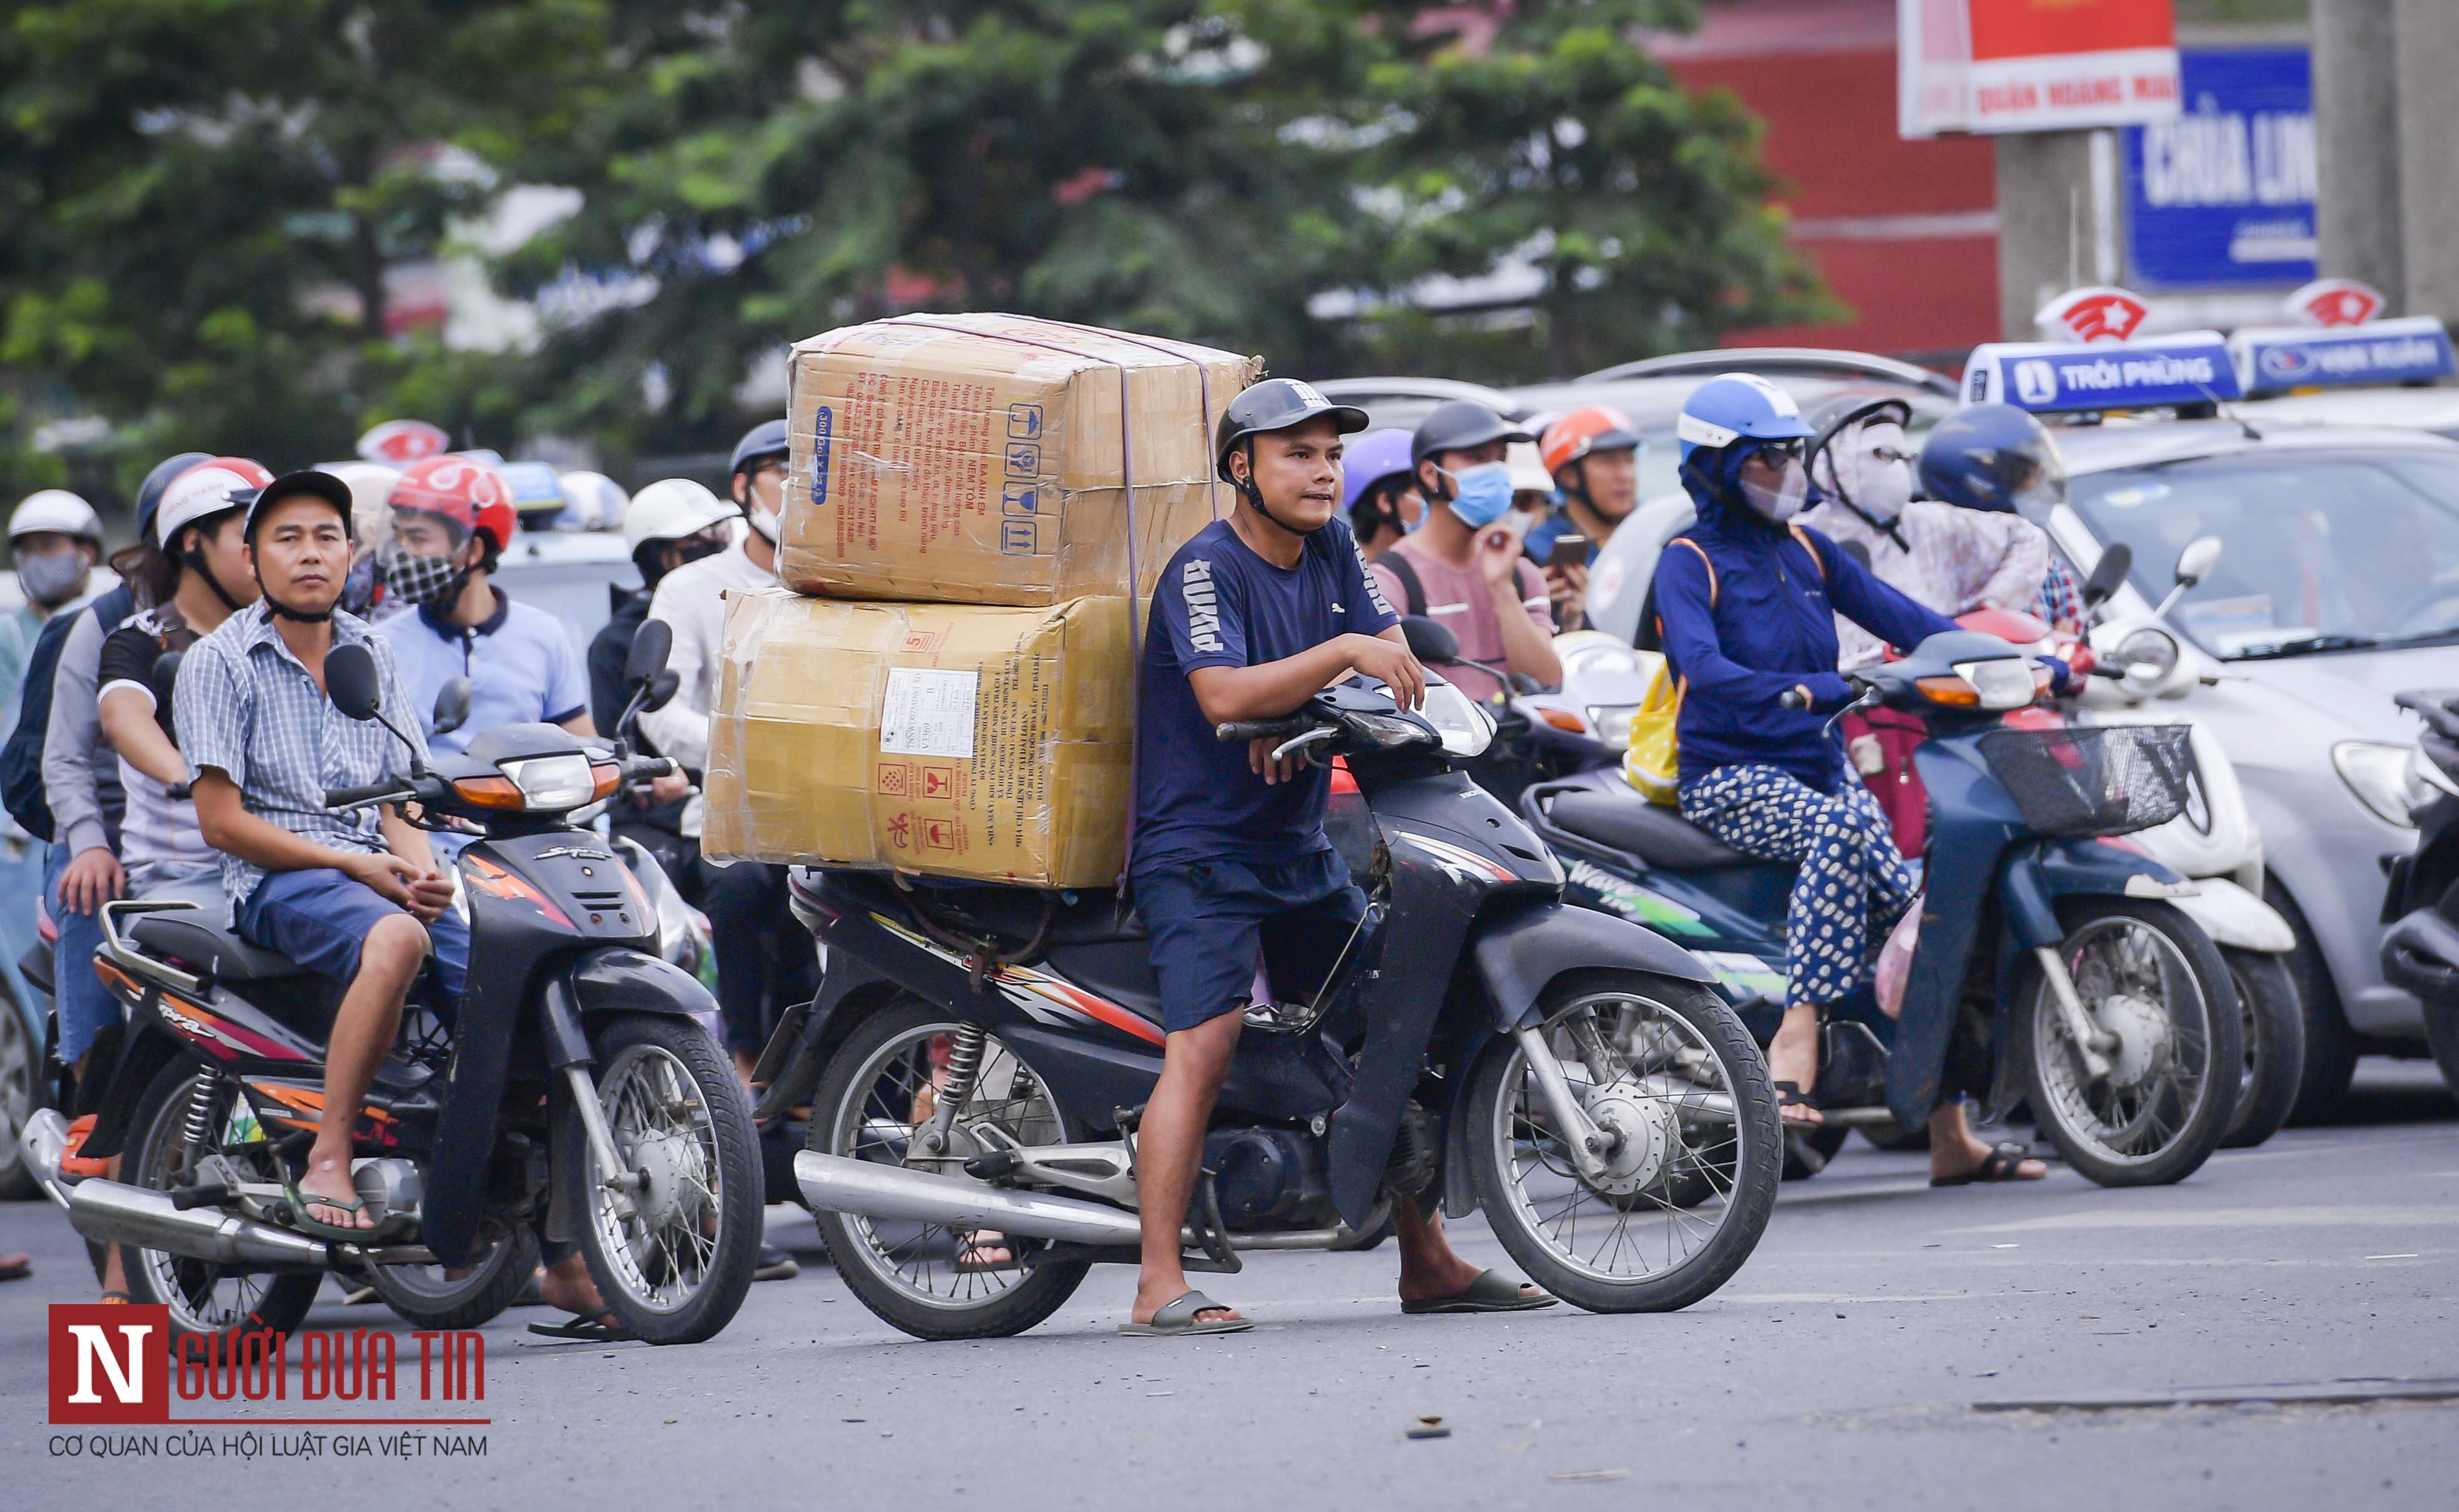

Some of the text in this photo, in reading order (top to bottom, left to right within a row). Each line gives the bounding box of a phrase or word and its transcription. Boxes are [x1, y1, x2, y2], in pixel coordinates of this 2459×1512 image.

[898, 377, 908, 393] Hạn
[920, 380, 930, 401] Cách
[974, 385, 983, 401] Tên
[819, 415, 827, 434] 300
[979, 463, 988, 476] BA
[965, 486, 976, 509] TÔM
[978, 479, 986, 499] ANH
[978, 502, 985, 516] EM
[1183, 559, 1224, 653] PUMA
[906, 637, 920, 646] 5
[988, 759, 996, 780] CÔNG
[968, 789, 977, 810] CÔNG
